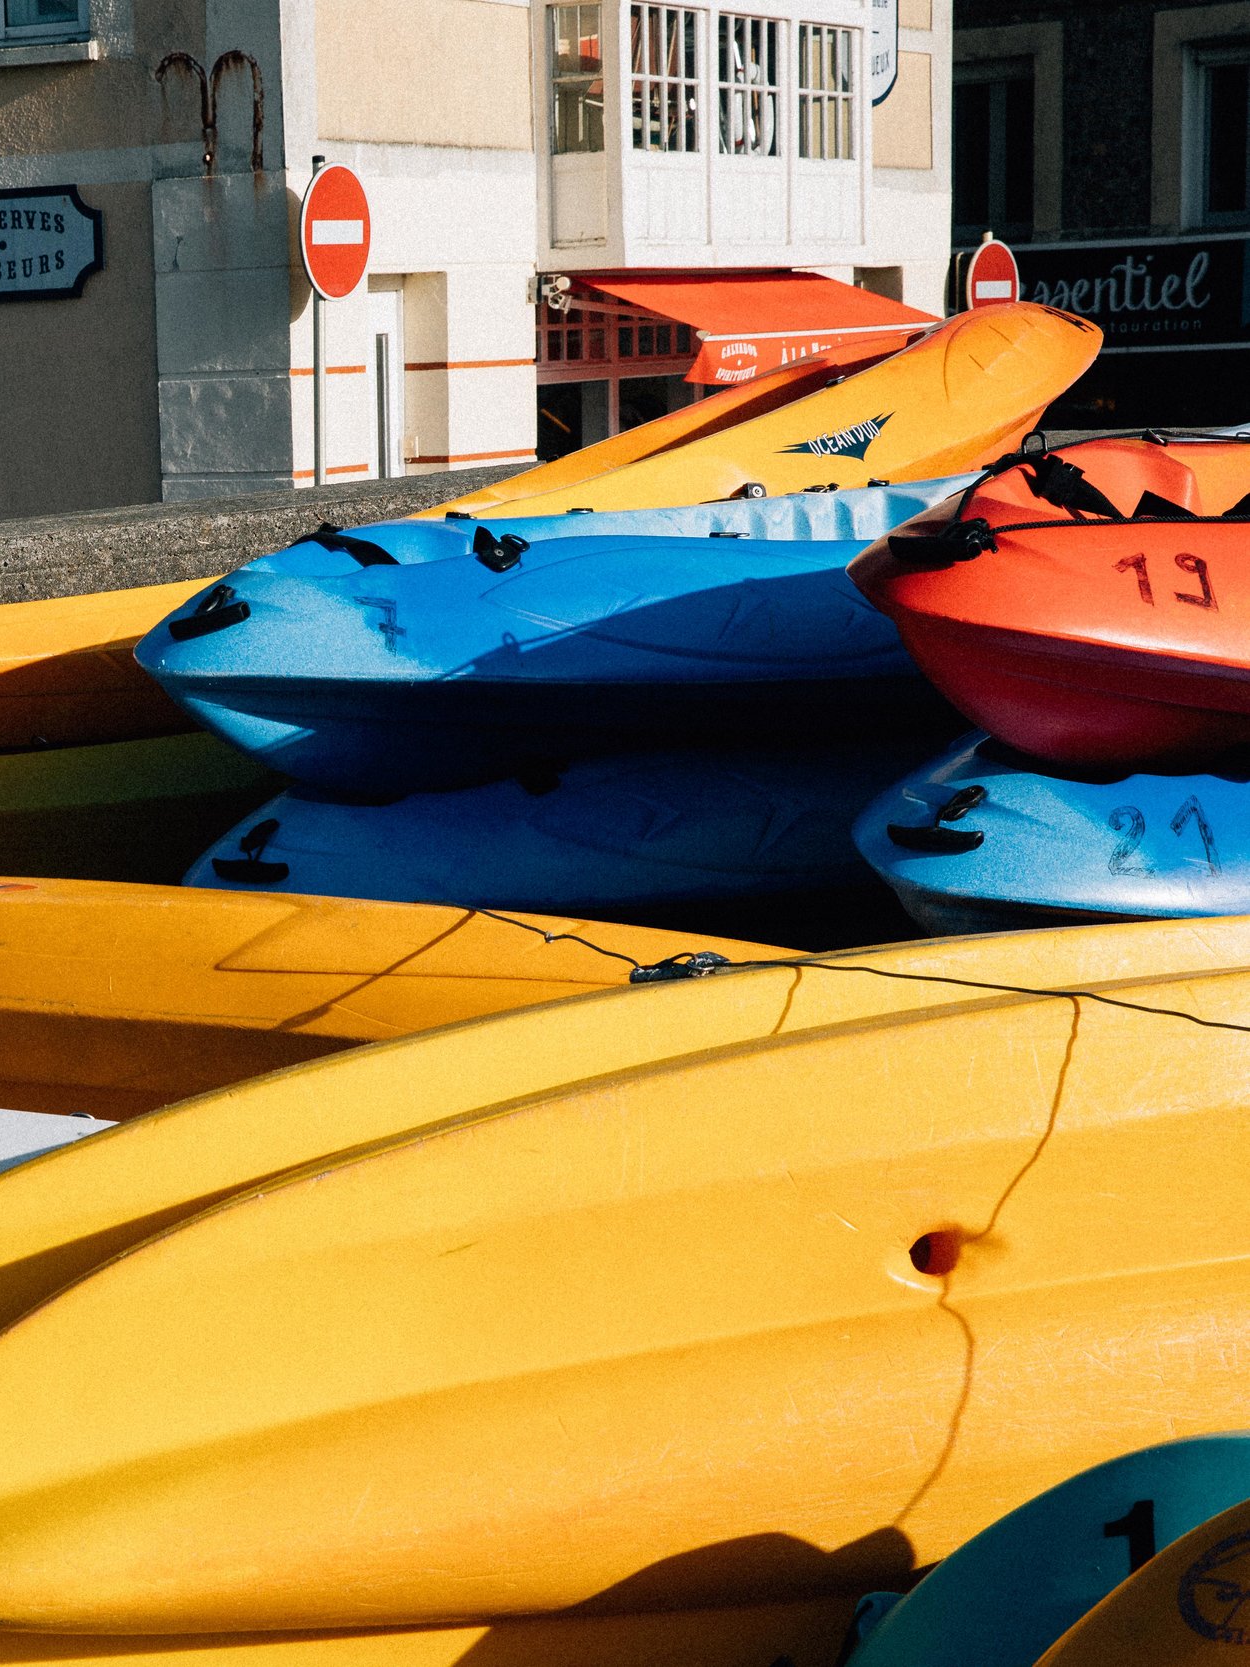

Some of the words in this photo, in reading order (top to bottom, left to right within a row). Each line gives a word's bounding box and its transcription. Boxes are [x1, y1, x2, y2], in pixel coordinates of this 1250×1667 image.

[1019, 251, 1211, 314] ssentiel
[1111, 552, 1219, 613] 19
[1108, 794, 1223, 879] 21
